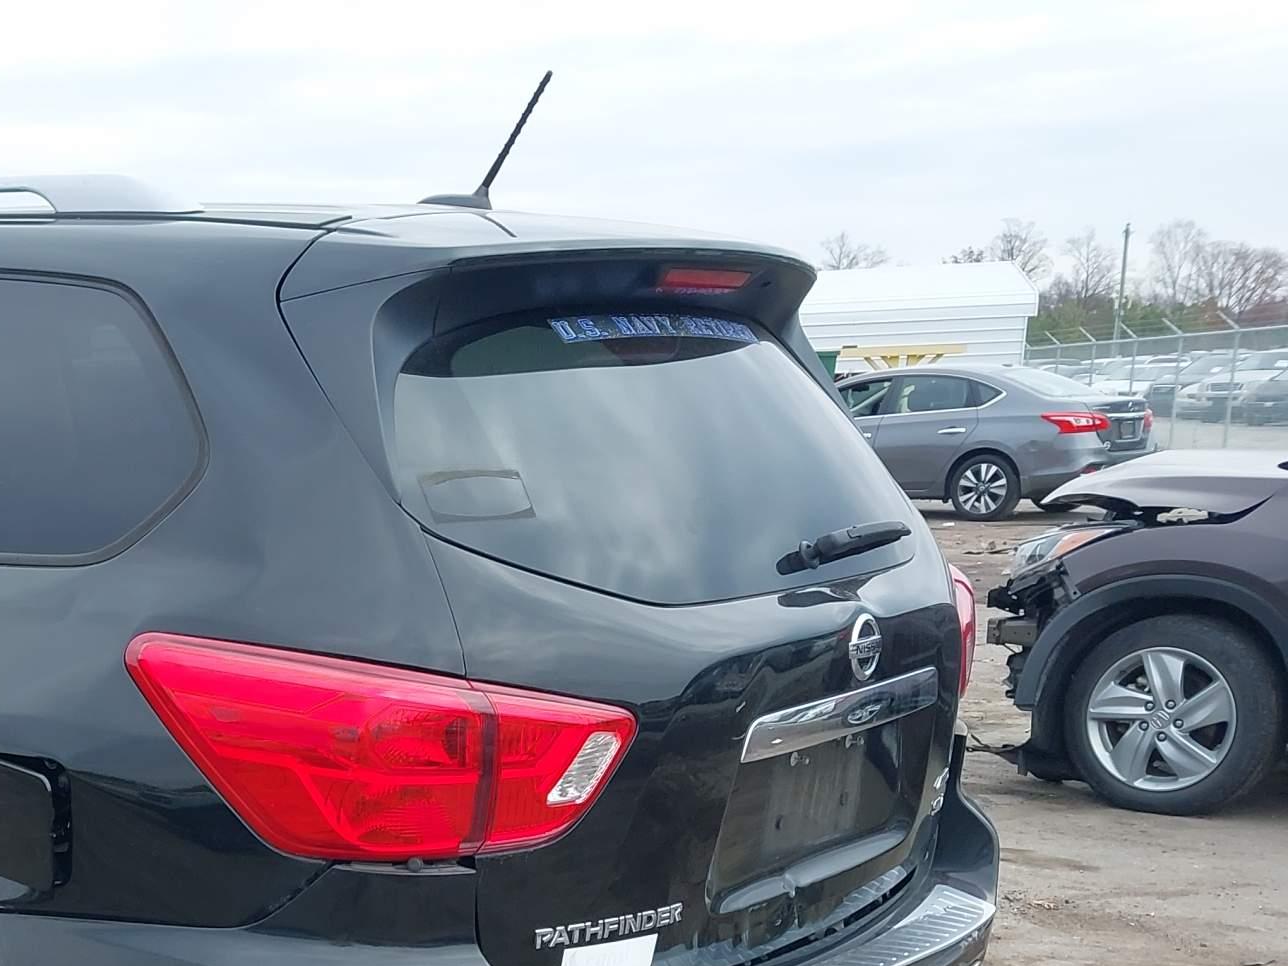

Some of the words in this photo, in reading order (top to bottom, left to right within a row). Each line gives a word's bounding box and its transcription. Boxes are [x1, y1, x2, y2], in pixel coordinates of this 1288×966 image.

[551, 319, 609, 340] U.S.
[612, 316, 676, 336] NAVY
[534, 902, 684, 950] PATHFINDER
